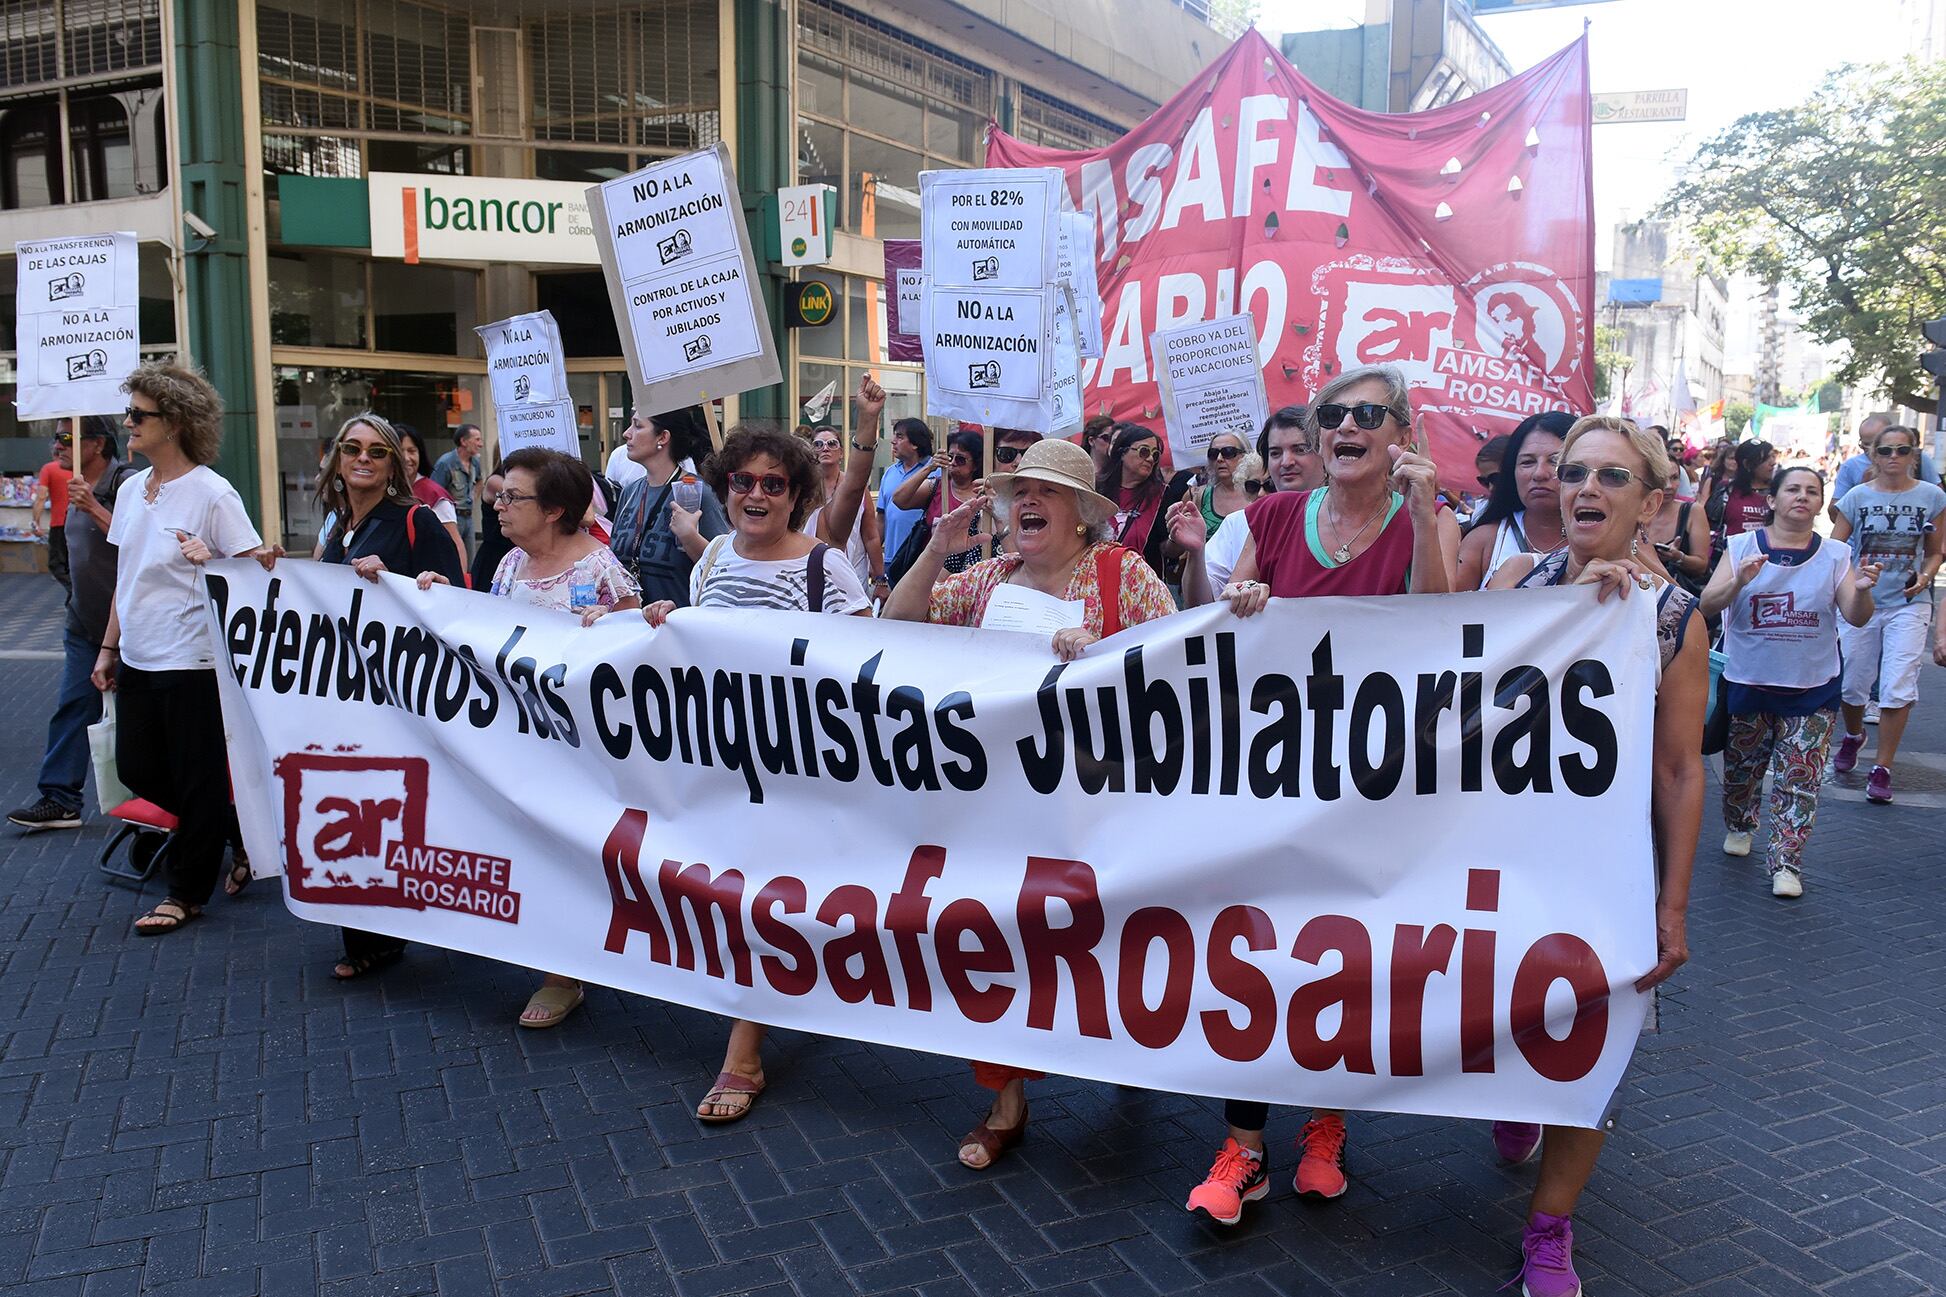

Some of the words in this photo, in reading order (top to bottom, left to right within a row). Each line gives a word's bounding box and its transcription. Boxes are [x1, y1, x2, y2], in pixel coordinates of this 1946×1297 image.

[633, 179, 659, 203] NO
[662, 182, 672, 194] A
[675, 172, 693, 189] LA
[568, 203, 588, 212] BAN
[952, 195, 972, 207] POR
[975, 195, 987, 207] EL
[990, 190, 1024, 206] 82%
[424, 187, 562, 234] bancor
[568, 214, 579, 223] DE
[617, 193, 723, 239] ARMONIZACIÓN
[784, 199, 808, 222] 24
[568, 225, 594, 235] CÓRD
[951, 220, 970, 231] CON
[971, 220, 1023, 231] MOVILIDAD
[20, 246, 33, 255] NO
[49, 239, 114, 252] TRANSFERENCIA
[957, 237, 1016, 250] AUTOMÁTICA
[28, 260, 43, 271] DE
[46, 256, 66, 269] LAS
[69, 253, 107, 266] CAJAS
[633, 285, 679, 307] CONTROL
[681, 281, 695, 294] DE
[697, 276, 710, 289] LA
[711, 268, 740, 285] CAJA
[901, 276, 916, 286] NO
[652, 307, 673, 321] POR
[675, 295, 718, 316] ACTIVOS
[718, 291, 726, 302] Y
[801, 296, 828, 310] LINK
[957, 300, 982, 320] NO
[984, 305, 994, 320] A
[997, 306, 1014, 321] LA
[63, 314, 80, 325] NO
[83, 314, 91, 323] A
[94, 312, 109, 323] LA
[665, 313, 721, 337] JUBILADOS
[1083, 260, 1288, 389] ARIO
[40, 328, 134, 348] ARMONIZACIÓN
[514, 331, 520, 342] A
[520, 329, 532, 341] LA
[935, 333, 1037, 354] ARMONIZACIÓN
[1168, 333, 1206, 350] COBRO
[1208, 330, 1222, 341] YA
[1224, 325, 1246, 338] DEL
[1169, 340, 1251, 365] PROPORCIONAL
[1172, 367, 1186, 379] DE
[1188, 353, 1253, 376] VACACIONES
[1437, 351, 1559, 393] AMSAFE
[1185, 395, 1227, 409] precarización
[1227, 390, 1249, 400] laboral
[1203, 388, 1221, 398] Abajo
[1448, 379, 1571, 415] ROSARIO
[545, 409, 555, 419] NO
[1199, 408, 1240, 421] reemplazante
[1201, 402, 1236, 414] Compañero
[1191, 419, 1214, 429] sumate
[1219, 416, 1233, 424] esta
[1233, 413, 1251, 421] lucha
[205, 574, 500, 729] Defendamos
[496, 625, 582, 749] las
[590, 637, 988, 804] conquistas
[1016, 624, 1619, 802] Jubilatorias
[314, 796, 402, 862] ar
[389, 845, 507, 888] AMSAFE
[403, 878, 516, 919] ROSARIO
[602, 808, 1611, 1083] AmsafeRosario
